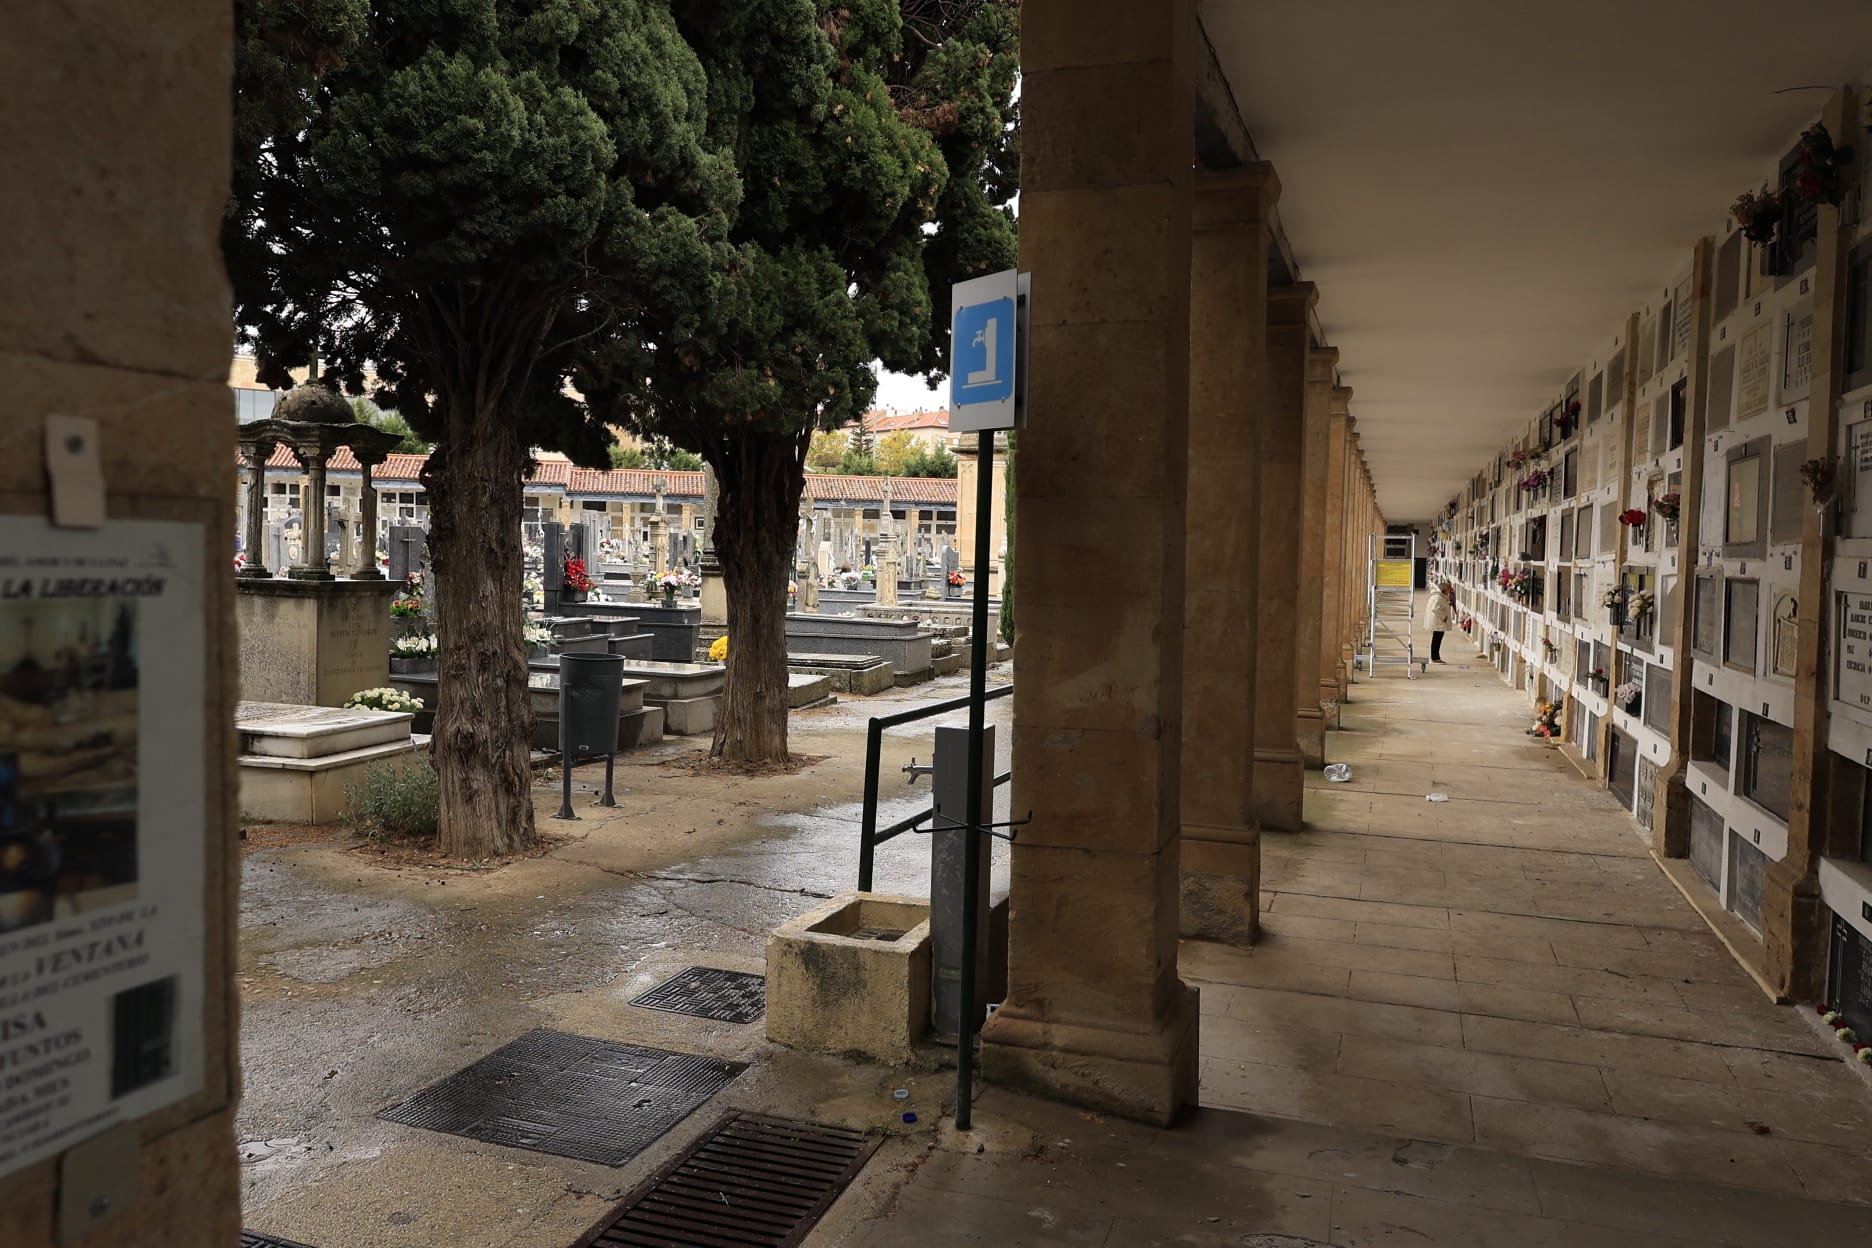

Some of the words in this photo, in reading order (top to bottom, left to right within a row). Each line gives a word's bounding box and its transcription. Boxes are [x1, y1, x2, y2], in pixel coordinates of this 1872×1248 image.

[2, 578, 32, 598] LA
[40, 573, 168, 598] LIBERACIÓN
[36, 928, 145, 975] VENTANA
[1, 1010, 47, 1041] ISA
